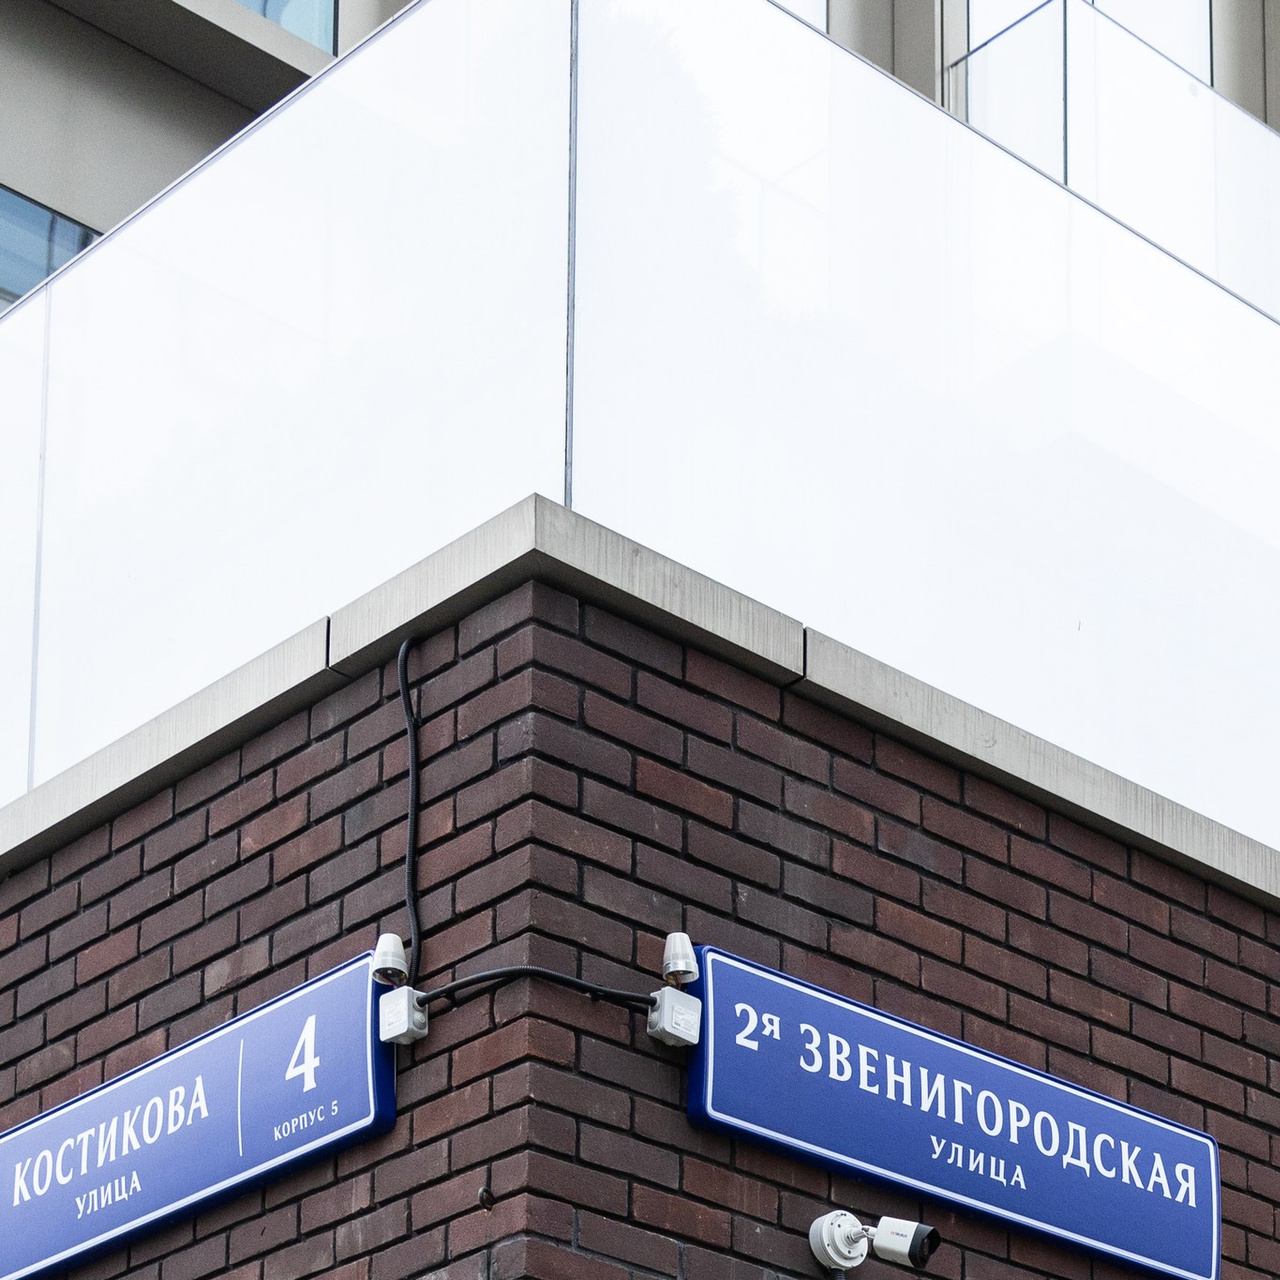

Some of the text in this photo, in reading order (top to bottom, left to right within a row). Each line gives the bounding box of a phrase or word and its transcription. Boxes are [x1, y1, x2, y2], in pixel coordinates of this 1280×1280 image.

[285, 1014, 321, 1093] 4
[12, 1075, 210, 1207] КОСТИКОВА
[273, 1100, 339, 1142] КОРПУС 5
[799, 1023, 1198, 1208] ЗВЕНИГОРОДСКАЯ
[75, 1170, 143, 1220] УЛИЦА
[929, 1133, 1028, 1191] УЛИЦА
